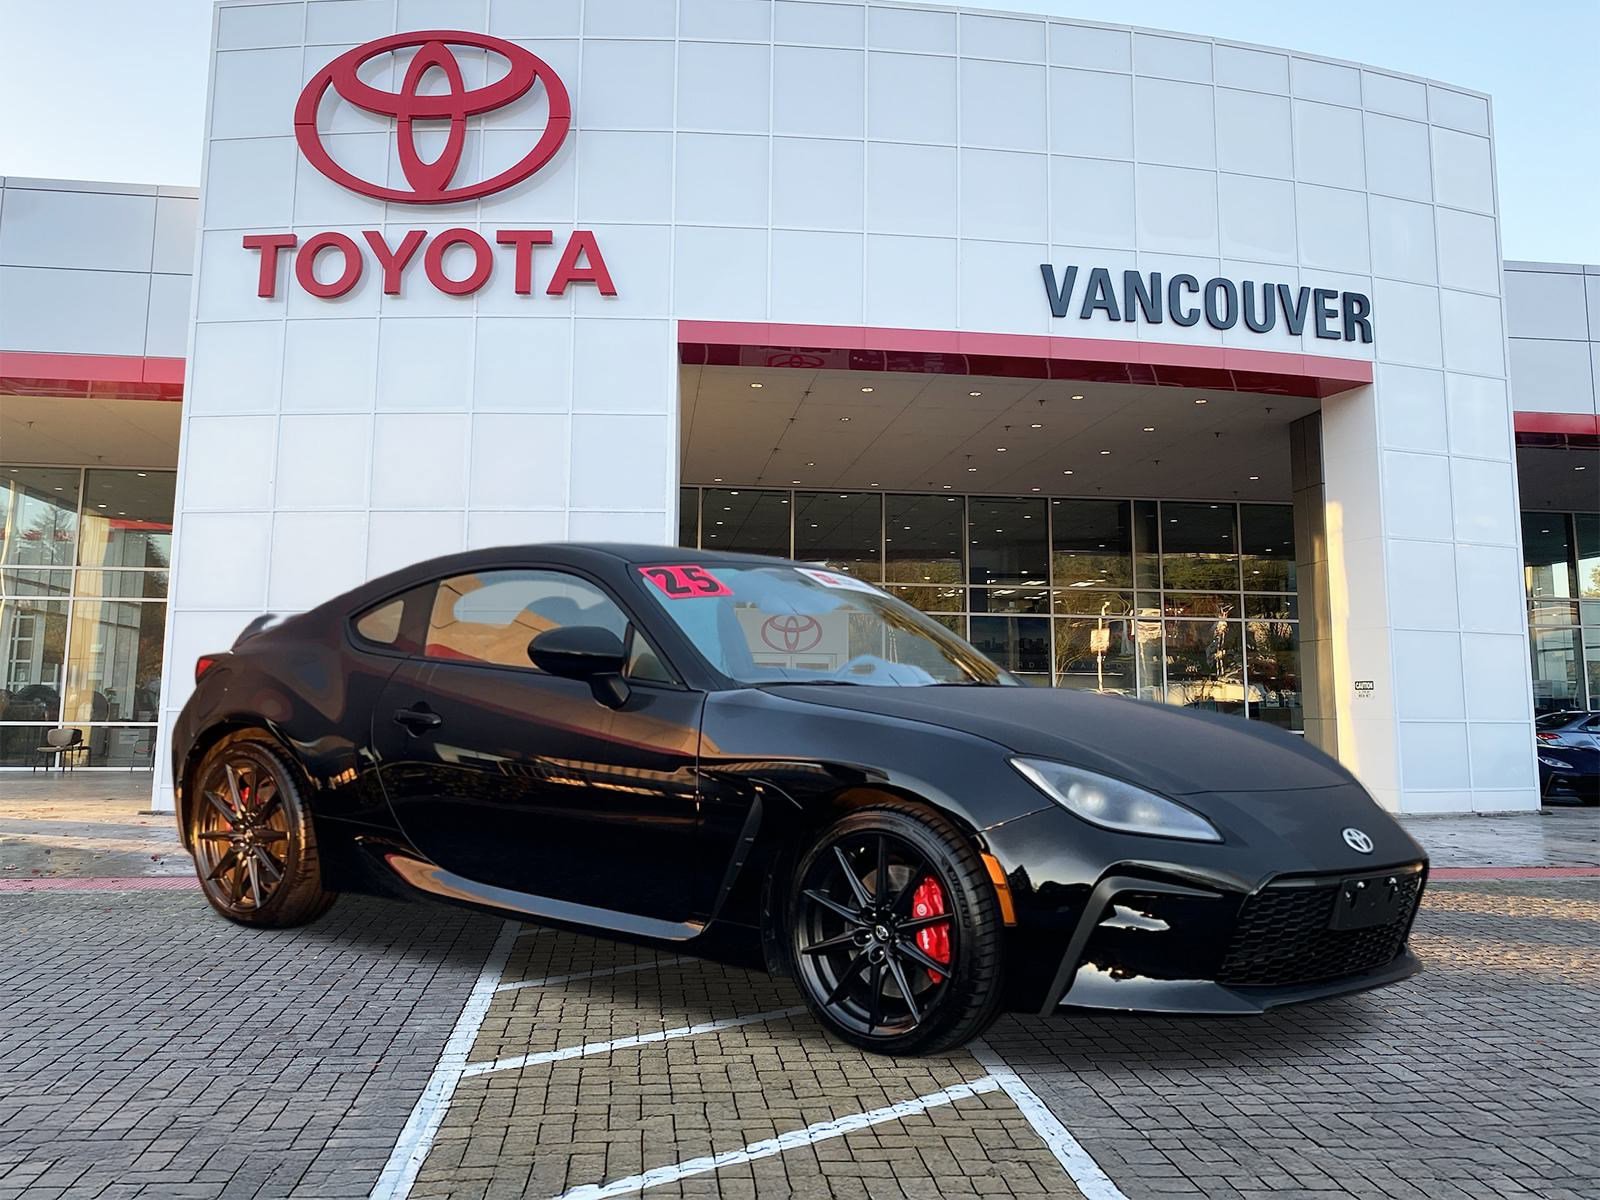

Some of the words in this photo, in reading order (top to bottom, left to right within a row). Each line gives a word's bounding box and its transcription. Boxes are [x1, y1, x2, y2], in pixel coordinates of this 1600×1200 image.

[243, 228, 617, 299] TOYOTA
[1040, 264, 1373, 343] VANCOUVER
[646, 568, 720, 594] 25
